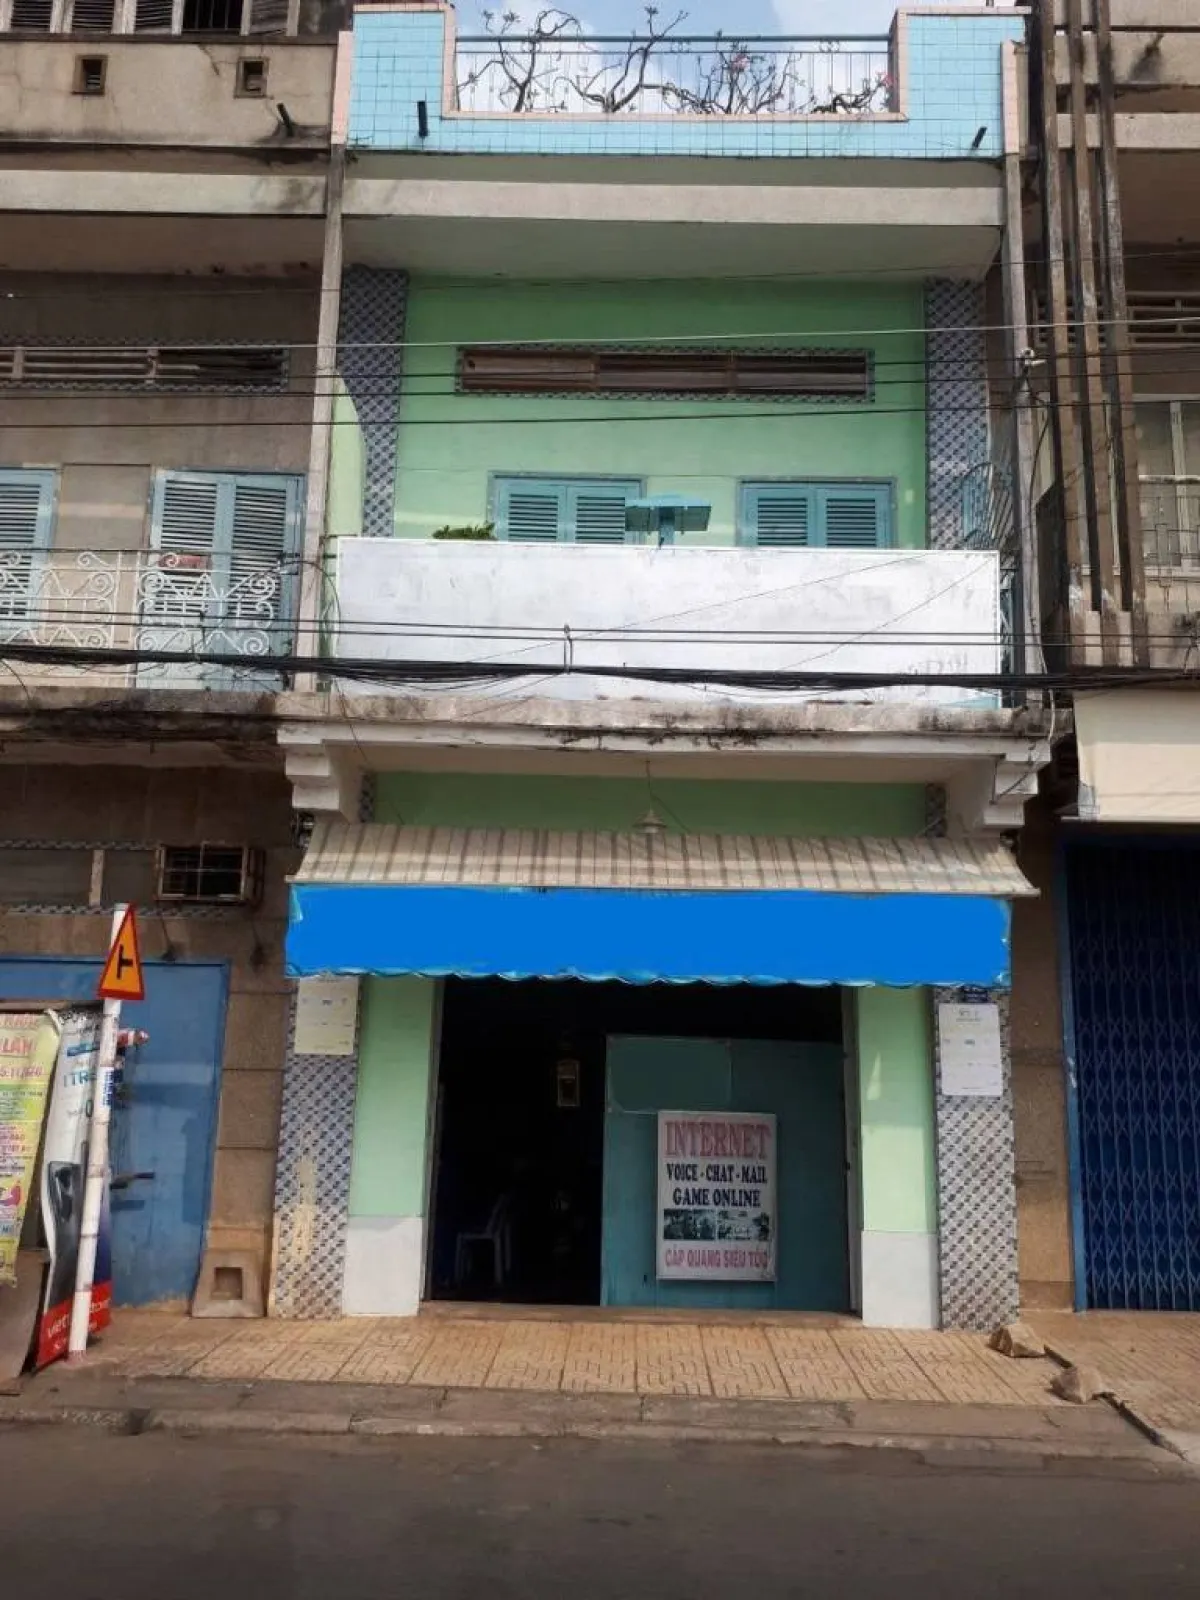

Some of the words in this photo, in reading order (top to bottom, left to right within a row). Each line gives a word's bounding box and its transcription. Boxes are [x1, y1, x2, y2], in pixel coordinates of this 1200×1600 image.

[664, 1121, 772, 1158] INTERNET
[666, 1163, 698, 1182] VOICE
[705, 1164, 735, 1182] CHAT
[741, 1165, 768, 1184] MAIL
[673, 1187, 710, 1206] GAME
[713, 1189, 761, 1207] ONLINE
[687, 1249, 721, 1269] QUANG
